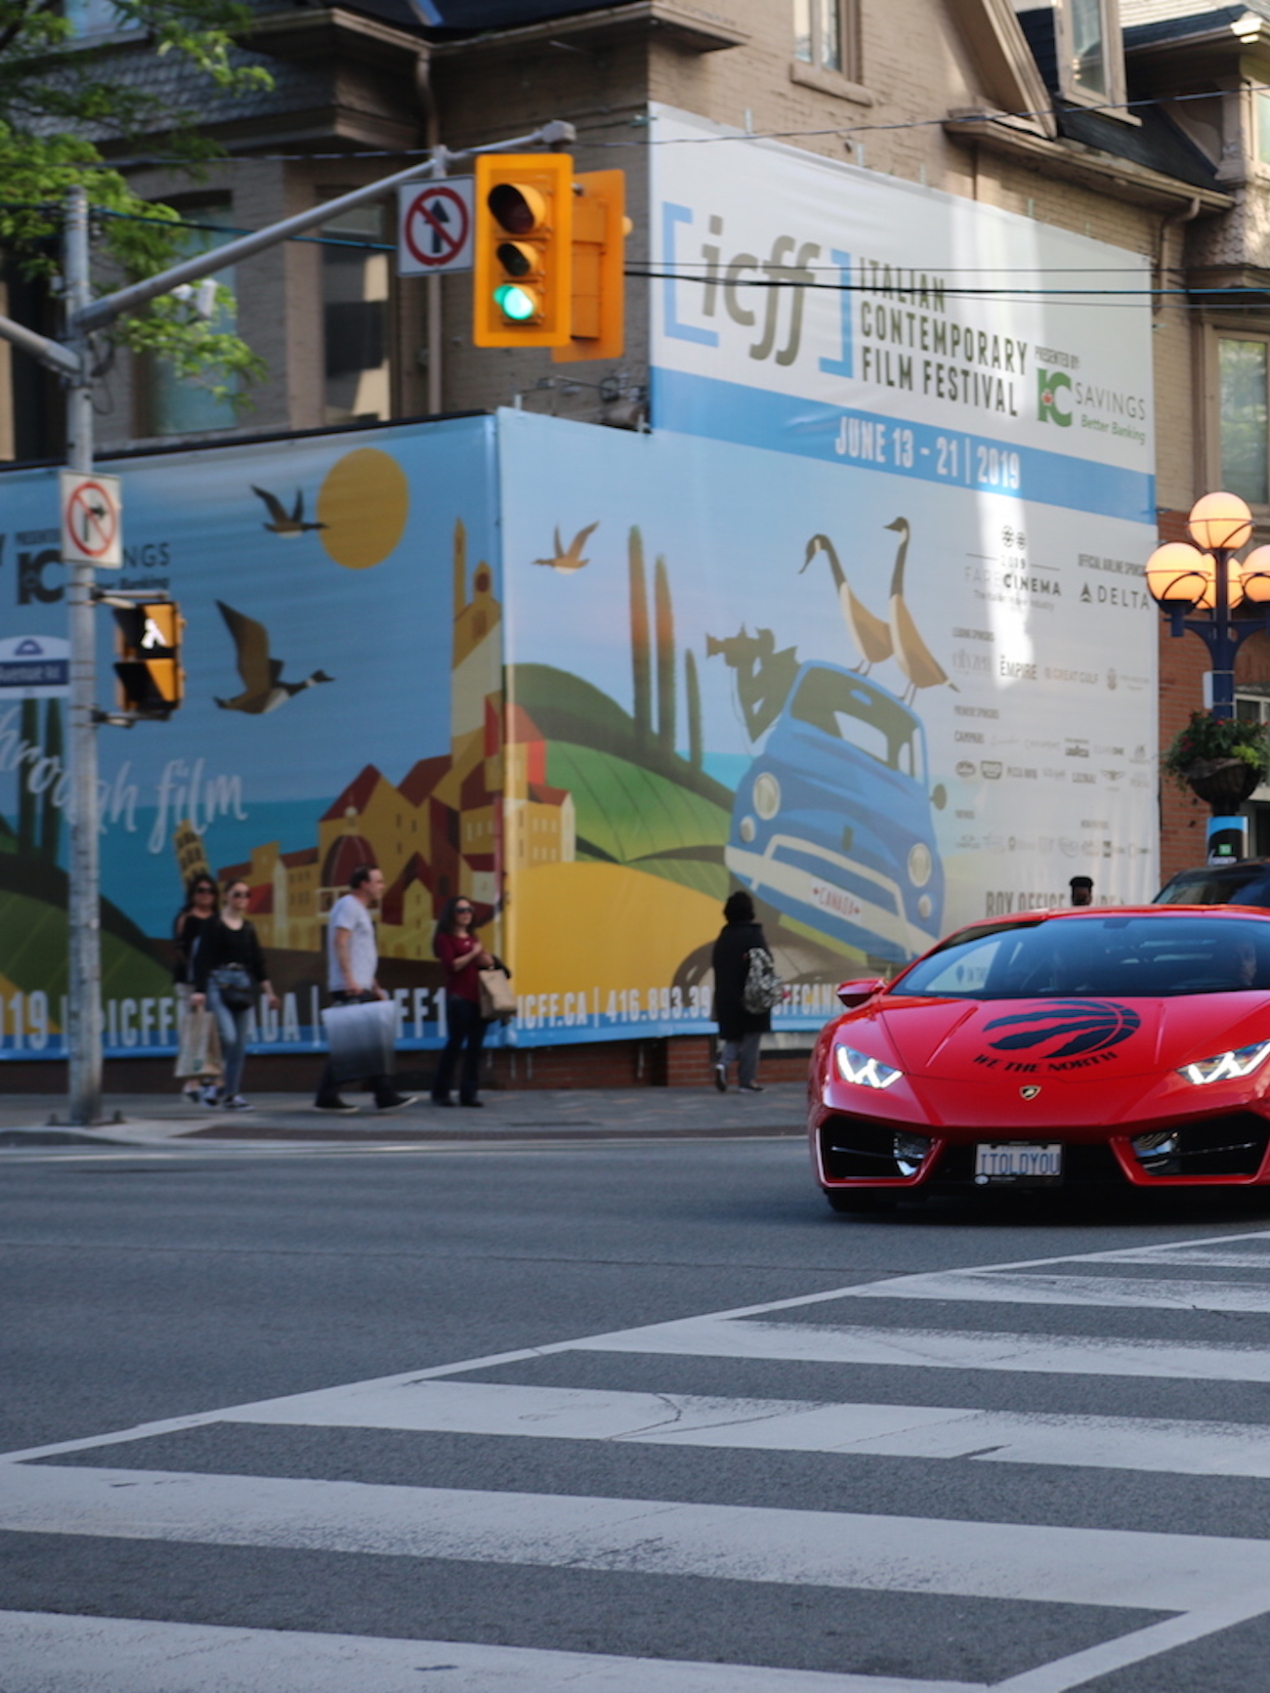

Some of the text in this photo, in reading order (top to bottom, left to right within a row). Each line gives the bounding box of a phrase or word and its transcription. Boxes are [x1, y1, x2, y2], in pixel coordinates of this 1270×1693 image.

[860, 257, 946, 314] ITALIAN
[861, 301, 1028, 376] CONTEMPORARY
[862, 346, 1019, 417] FILM FESTIVAL
[1075, 382, 1146, 420] SAVINGS
[835, 416, 887, 463] JUNE
[892, 427, 914, 469] 13
[936, 436, 959, 477] 21
[976, 445, 1022, 490] 2019
[1097, 585, 1150, 610] DELTA
[516, 991, 588, 1030] ICFF.CA
[973, 1051, 1119, 1073] WE THE NORTH
[981, 1152, 1060, 1175] ITOLDYOU
